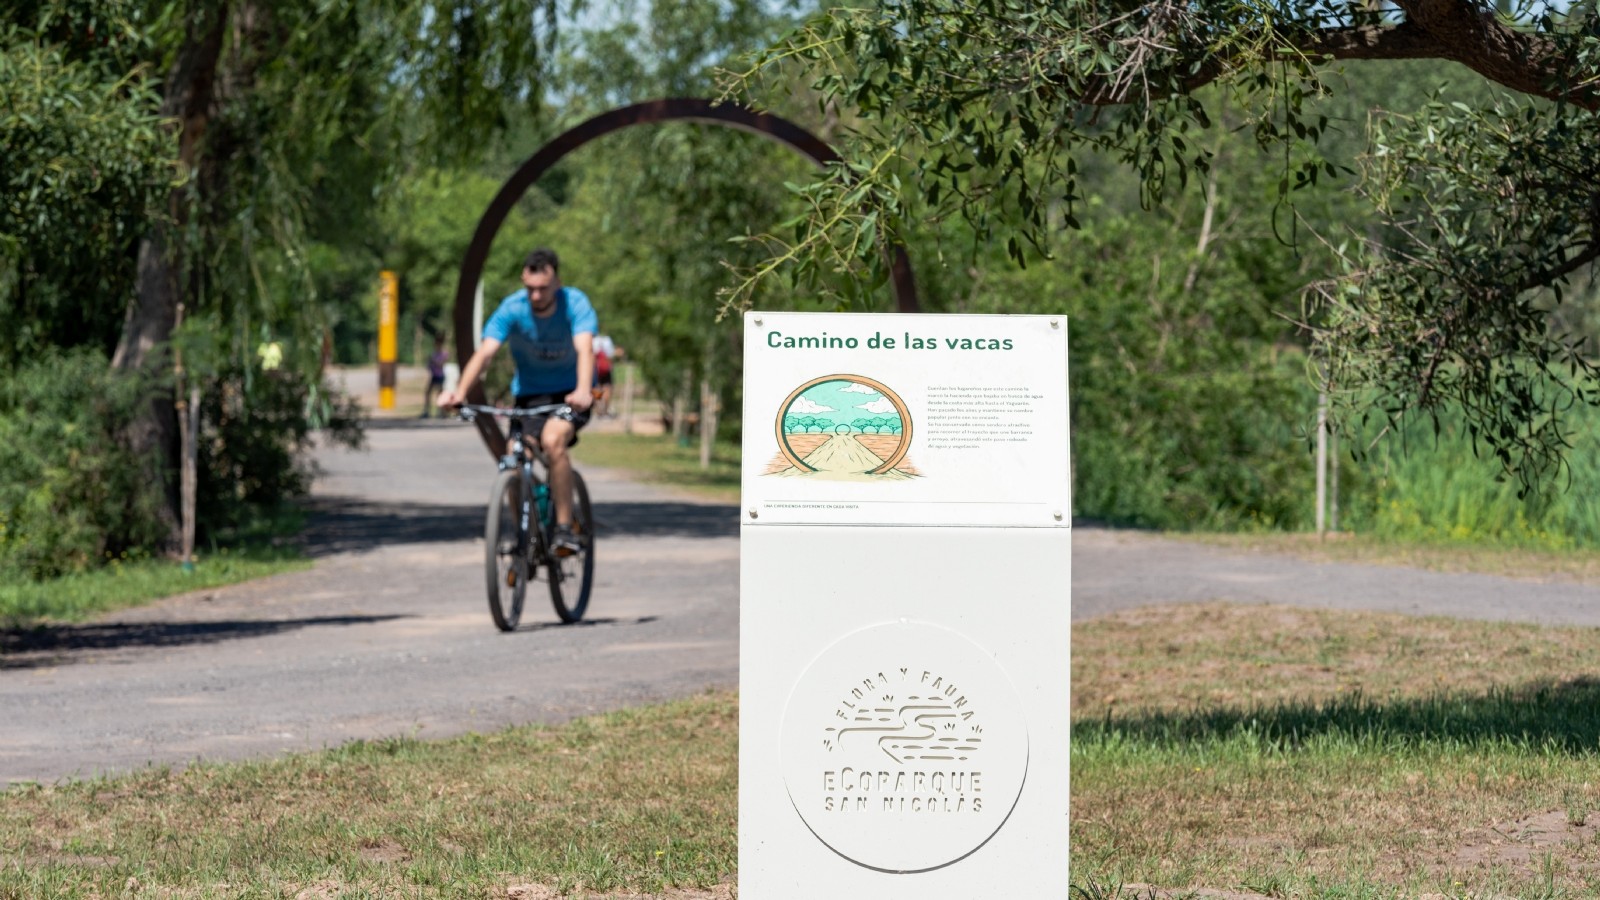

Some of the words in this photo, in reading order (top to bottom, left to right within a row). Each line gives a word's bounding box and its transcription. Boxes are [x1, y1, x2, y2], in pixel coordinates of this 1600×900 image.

[767, 331, 858, 348] Camino
[867, 332, 896, 349] de
[904, 332, 937, 350] las
[945, 338, 1014, 350] vacas
[836, 672, 888, 720] FLORA
[900, 668, 908, 681] Y
[921, 671, 974, 721] FAUNA
[824, 766, 982, 794] ECOPARQUE
[825, 797, 868, 812] SAN
[884, 794, 982, 812] NICOLÁS
